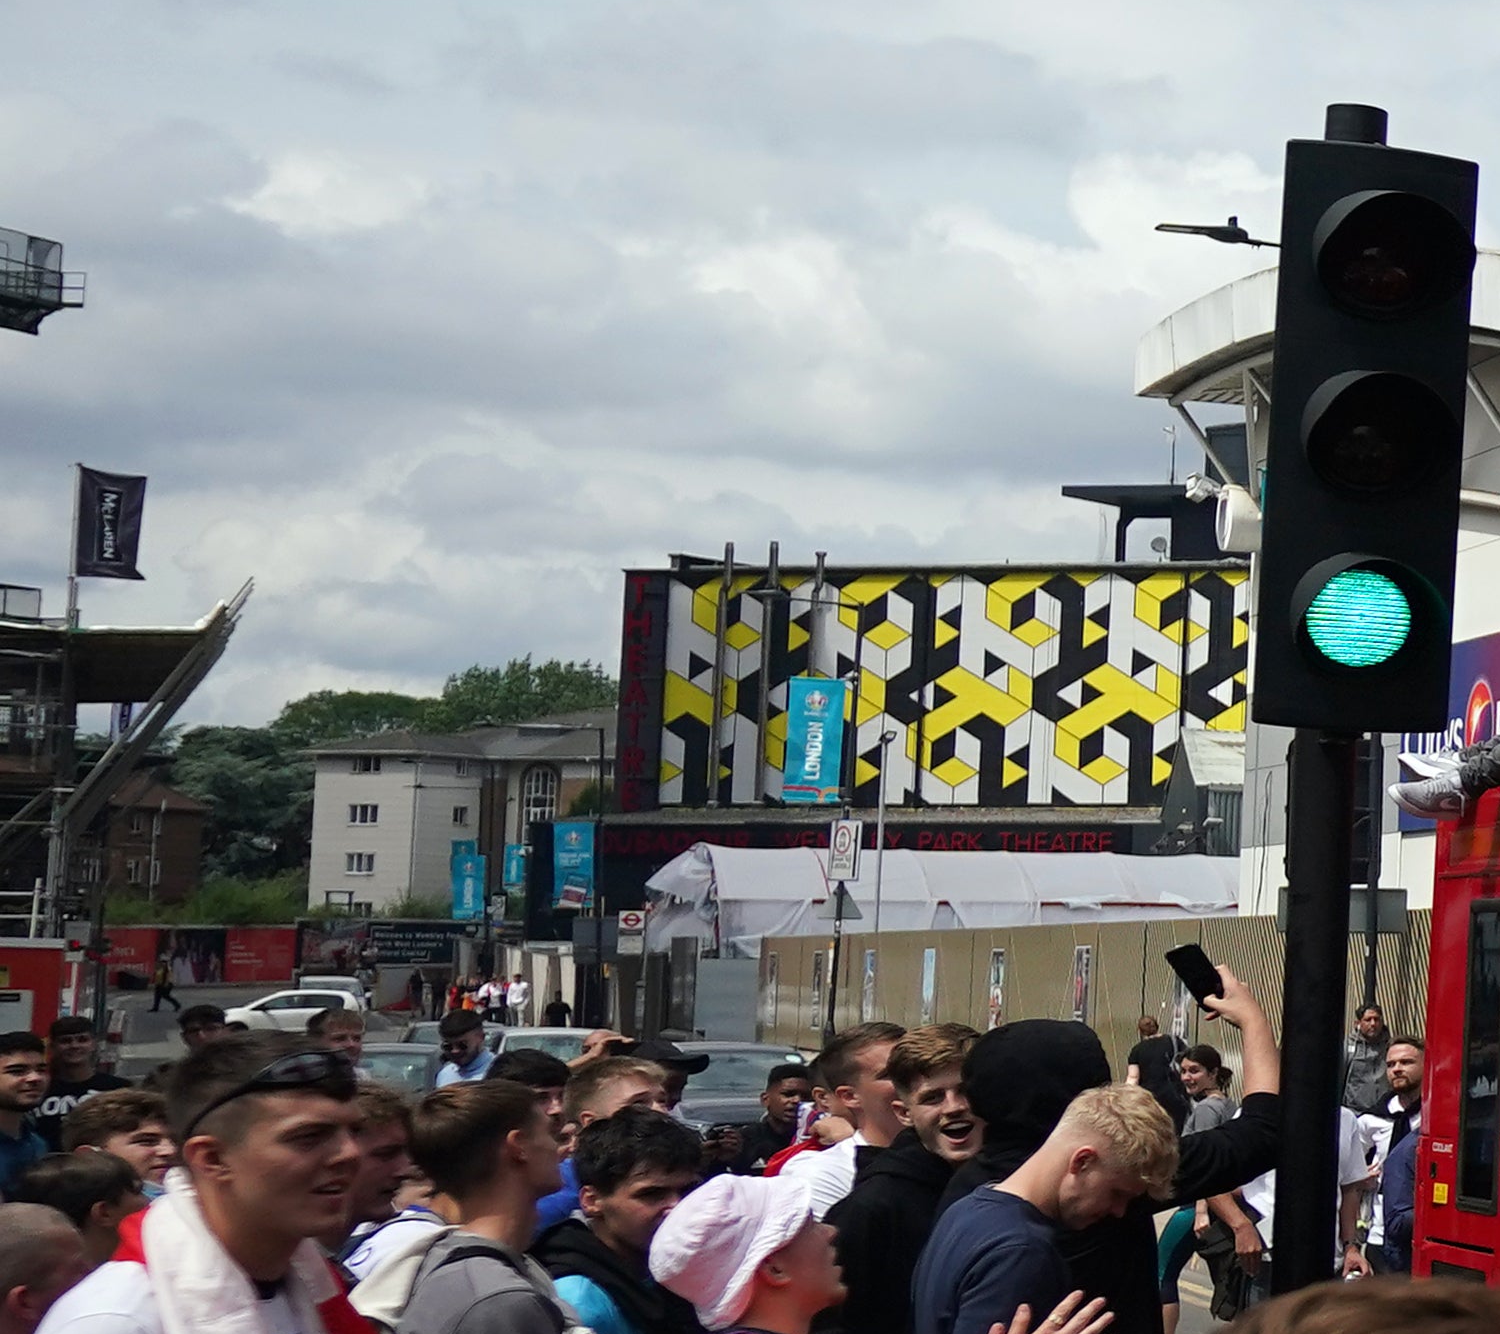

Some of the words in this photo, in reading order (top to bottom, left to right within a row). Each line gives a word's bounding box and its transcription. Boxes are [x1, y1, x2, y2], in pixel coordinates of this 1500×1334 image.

[622, 576, 652, 812] THEATRE
[804, 722, 823, 781] LONDON
[918, 831, 984, 851] PARK
[999, 831, 1114, 852] THEATRE
